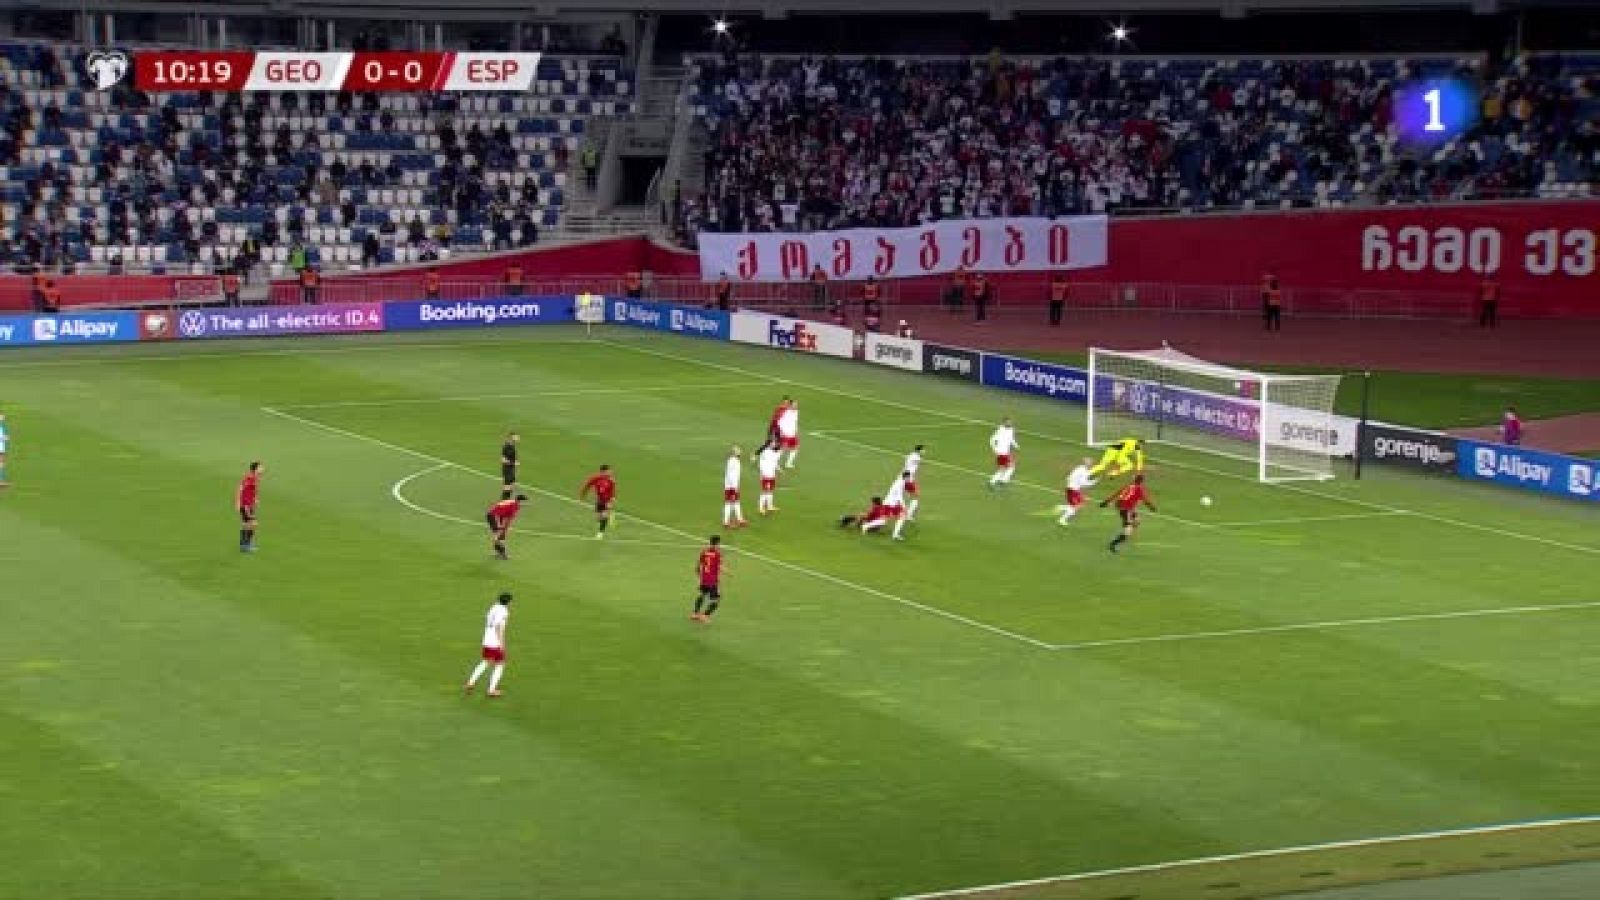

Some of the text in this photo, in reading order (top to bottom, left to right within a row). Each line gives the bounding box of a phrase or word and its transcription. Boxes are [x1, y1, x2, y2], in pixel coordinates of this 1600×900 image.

[210, 314, 243, 331] The
[247, 312, 341, 329] all-electric
[344, 308, 379, 326] ID.4
[419, 302, 540, 323] Booking.com
[59, 319, 118, 338] Alipay
[769, 319, 818, 350] FedEx
[1004, 361, 1087, 397] Booking.com
[1280, 421, 1339, 446] gorenje
[1499, 454, 1551, 486] Alipay
